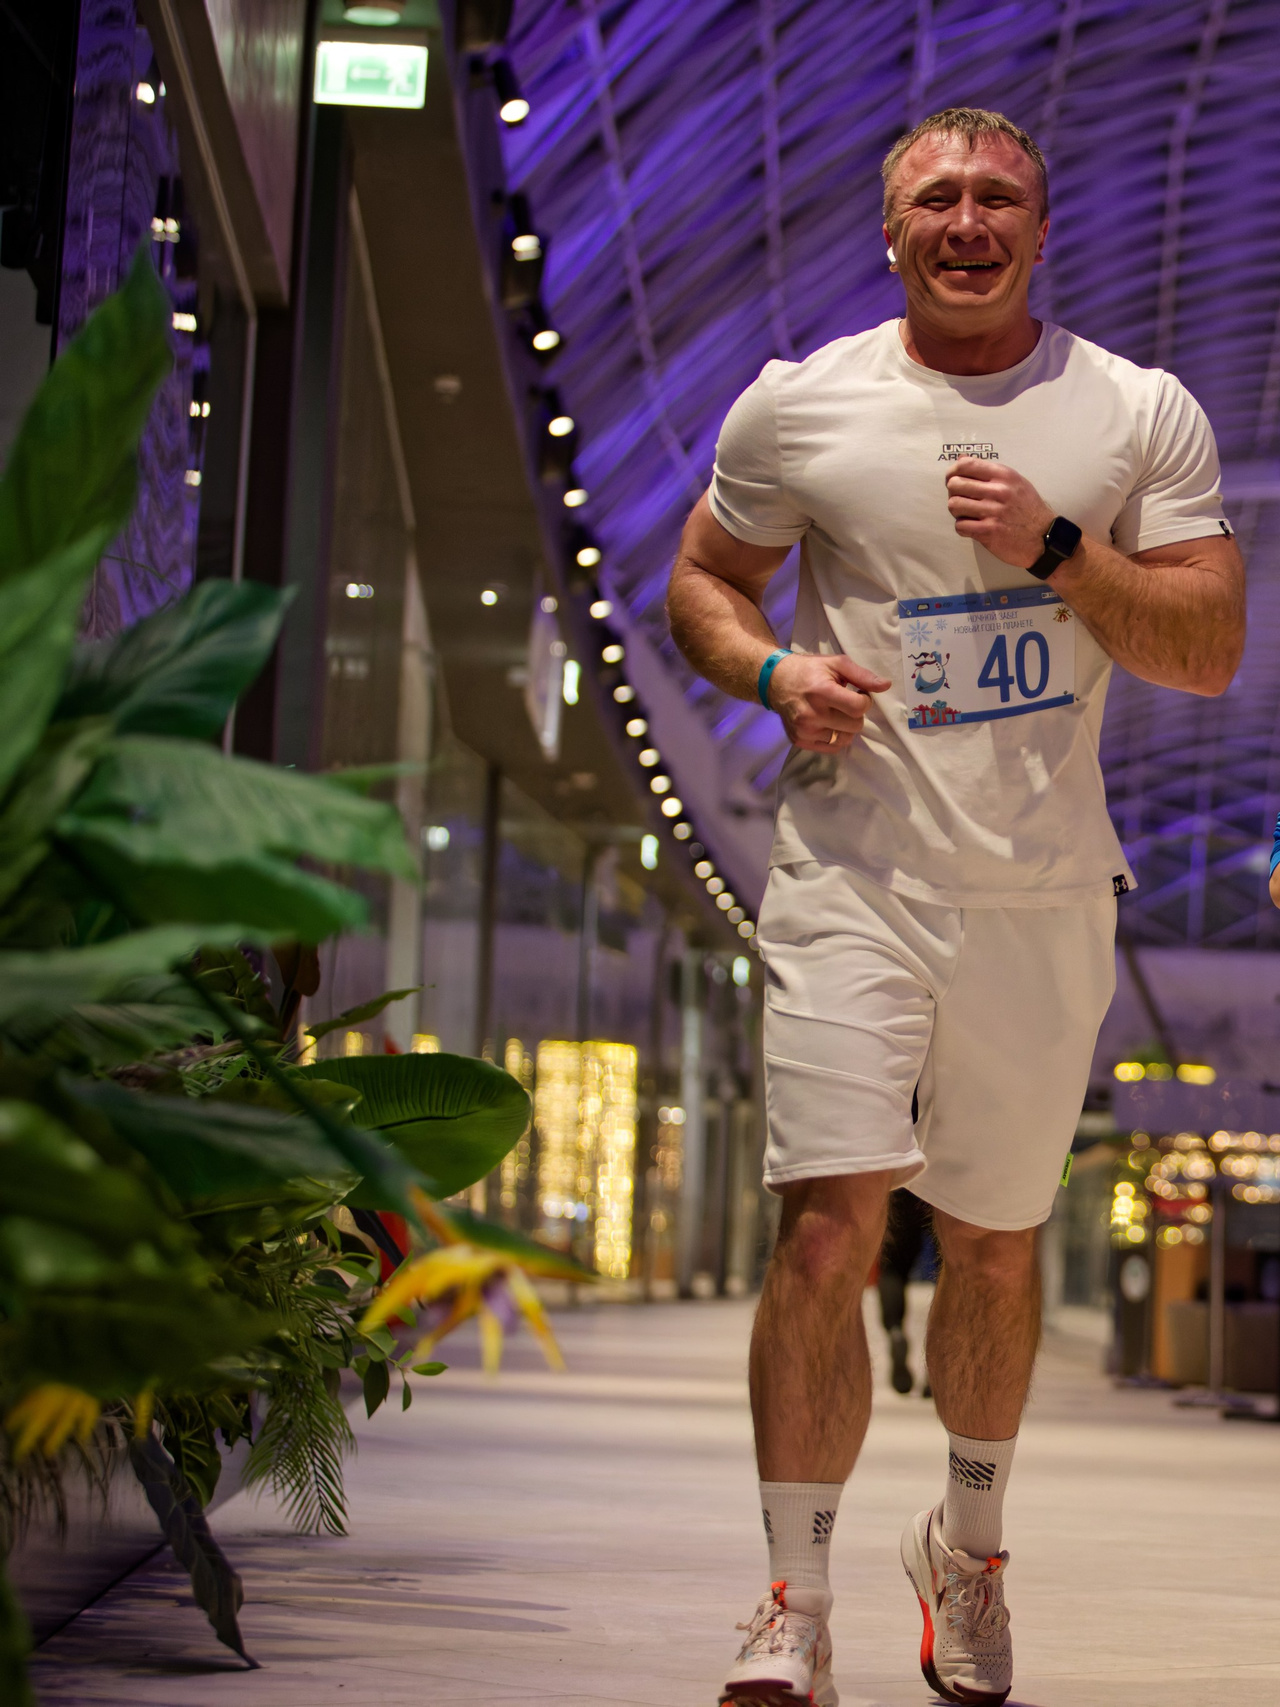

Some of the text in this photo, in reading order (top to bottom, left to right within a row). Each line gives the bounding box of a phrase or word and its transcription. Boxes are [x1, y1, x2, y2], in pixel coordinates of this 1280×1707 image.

[943, 443, 993, 453] UNDER
[967, 610, 997, 622] НОЧНОЙ
[954, 624, 979, 634] НОВЫЙ
[981, 622, 995, 632] ГОД
[977, 631, 1050, 702] 40
